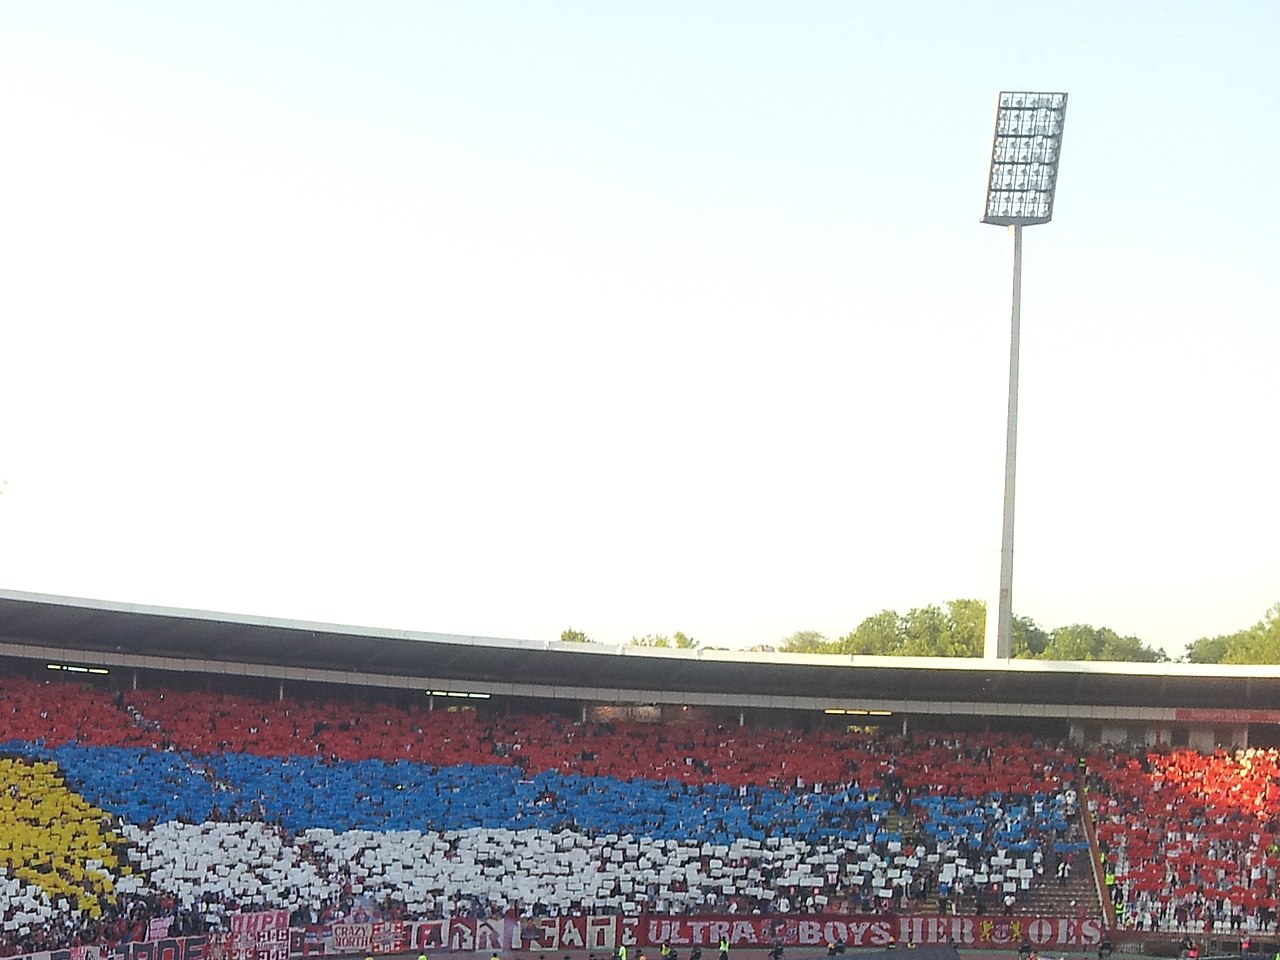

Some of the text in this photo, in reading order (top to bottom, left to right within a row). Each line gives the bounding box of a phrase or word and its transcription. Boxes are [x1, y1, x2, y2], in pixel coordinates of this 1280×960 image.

[335, 926, 368, 937] CRAZY
[648, 920, 891, 945] ULTRA BOYS
[335, 937, 370, 948] NORTH
